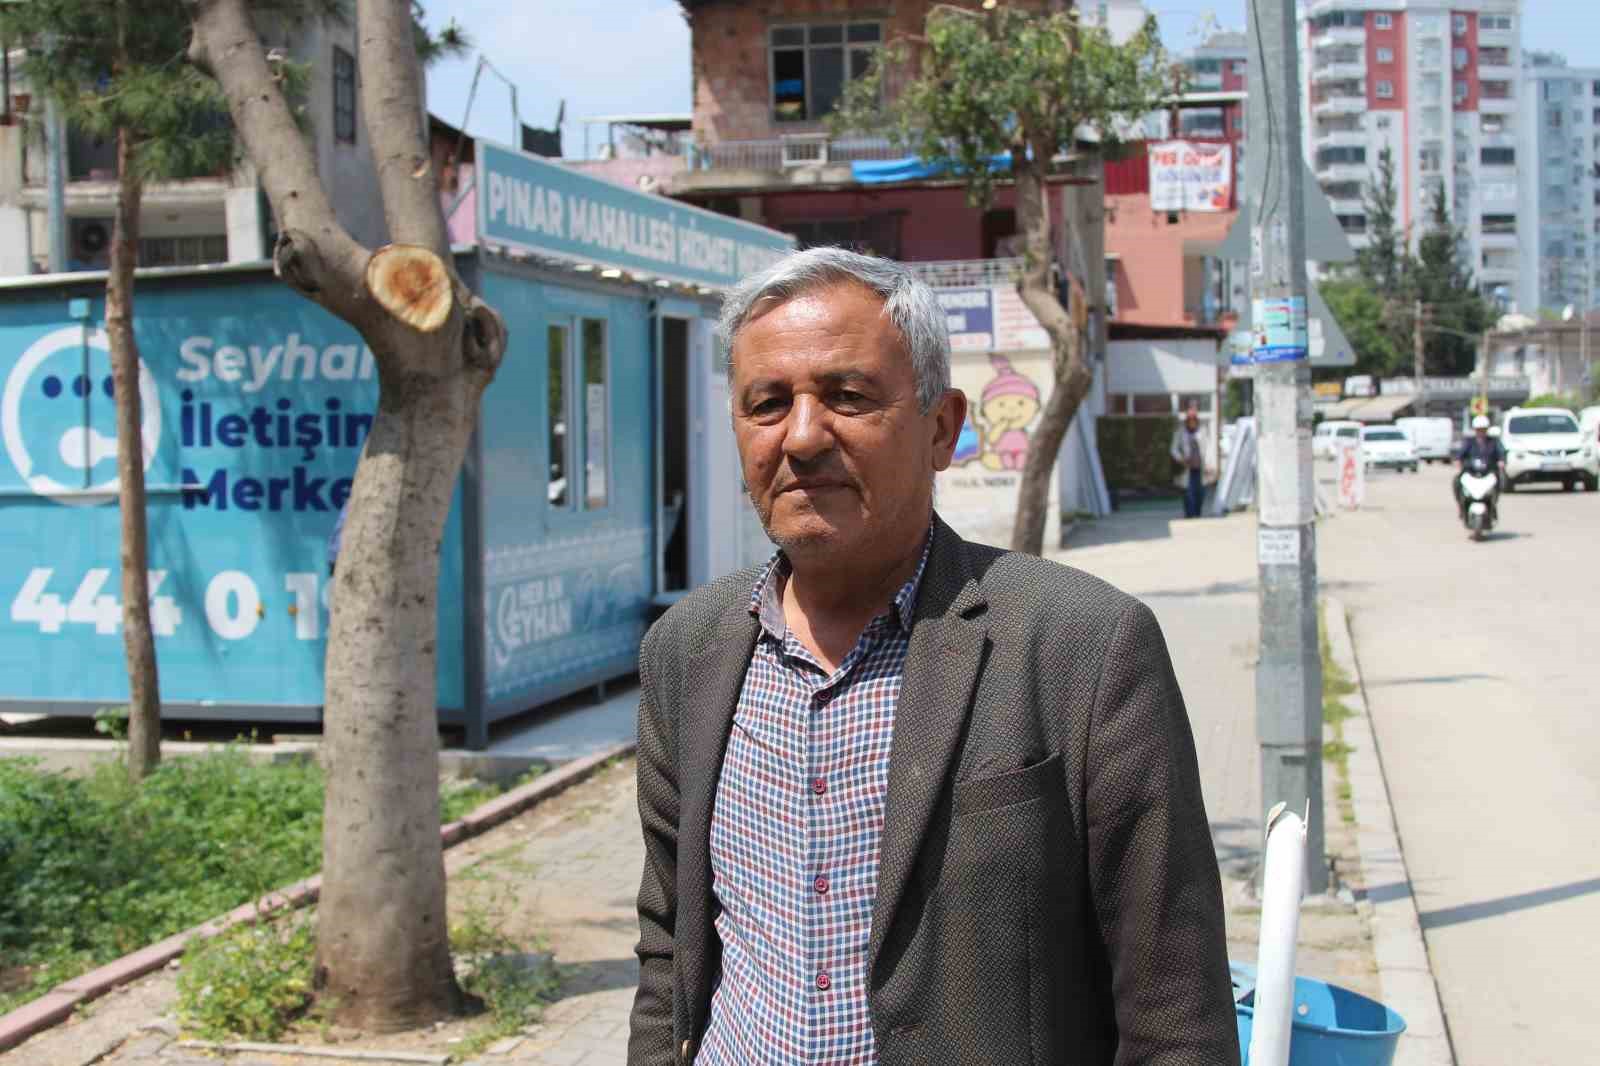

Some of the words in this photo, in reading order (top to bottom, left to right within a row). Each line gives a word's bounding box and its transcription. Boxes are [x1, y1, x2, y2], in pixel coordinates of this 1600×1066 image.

[488, 171, 563, 238] PINAR
[567, 194, 676, 263] MAHALLESİ
[181, 465, 354, 512] Merke
[285, 572, 334, 640] 1
